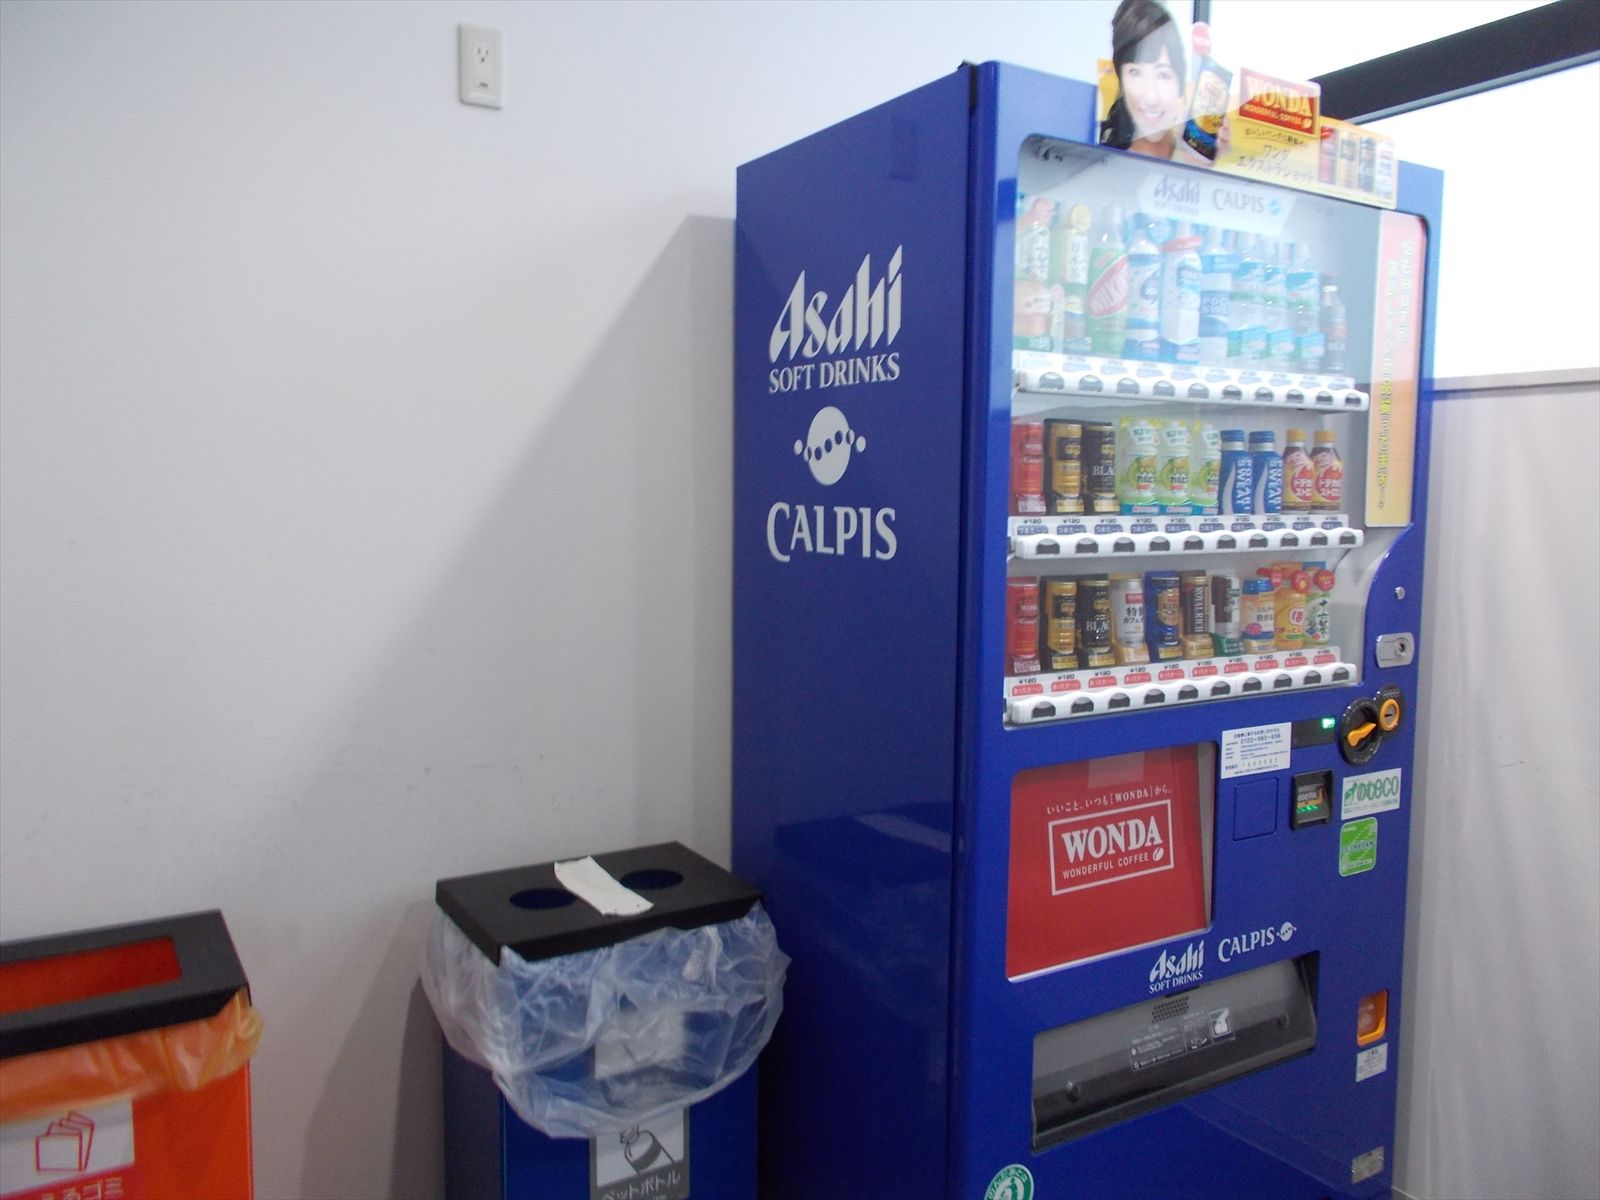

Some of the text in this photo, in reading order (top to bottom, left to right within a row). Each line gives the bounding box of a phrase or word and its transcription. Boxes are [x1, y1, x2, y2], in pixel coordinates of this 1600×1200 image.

[1245, 75, 1313, 117] WONDA
[1154, 174, 1265, 213] Asahi CALPIS
[769, 244, 903, 364] Asahi
[768, 352, 901, 394] SOFT DRINKS
[766, 501, 898, 563] CALPIS
[1061, 815, 1164, 864] WONDA
[1062, 852, 1149, 879] WONDERFUL COFFEE
[1149, 926, 1275, 983] Asahi CALPIS
[1148, 970, 1204, 994] SOFT DRINKS
